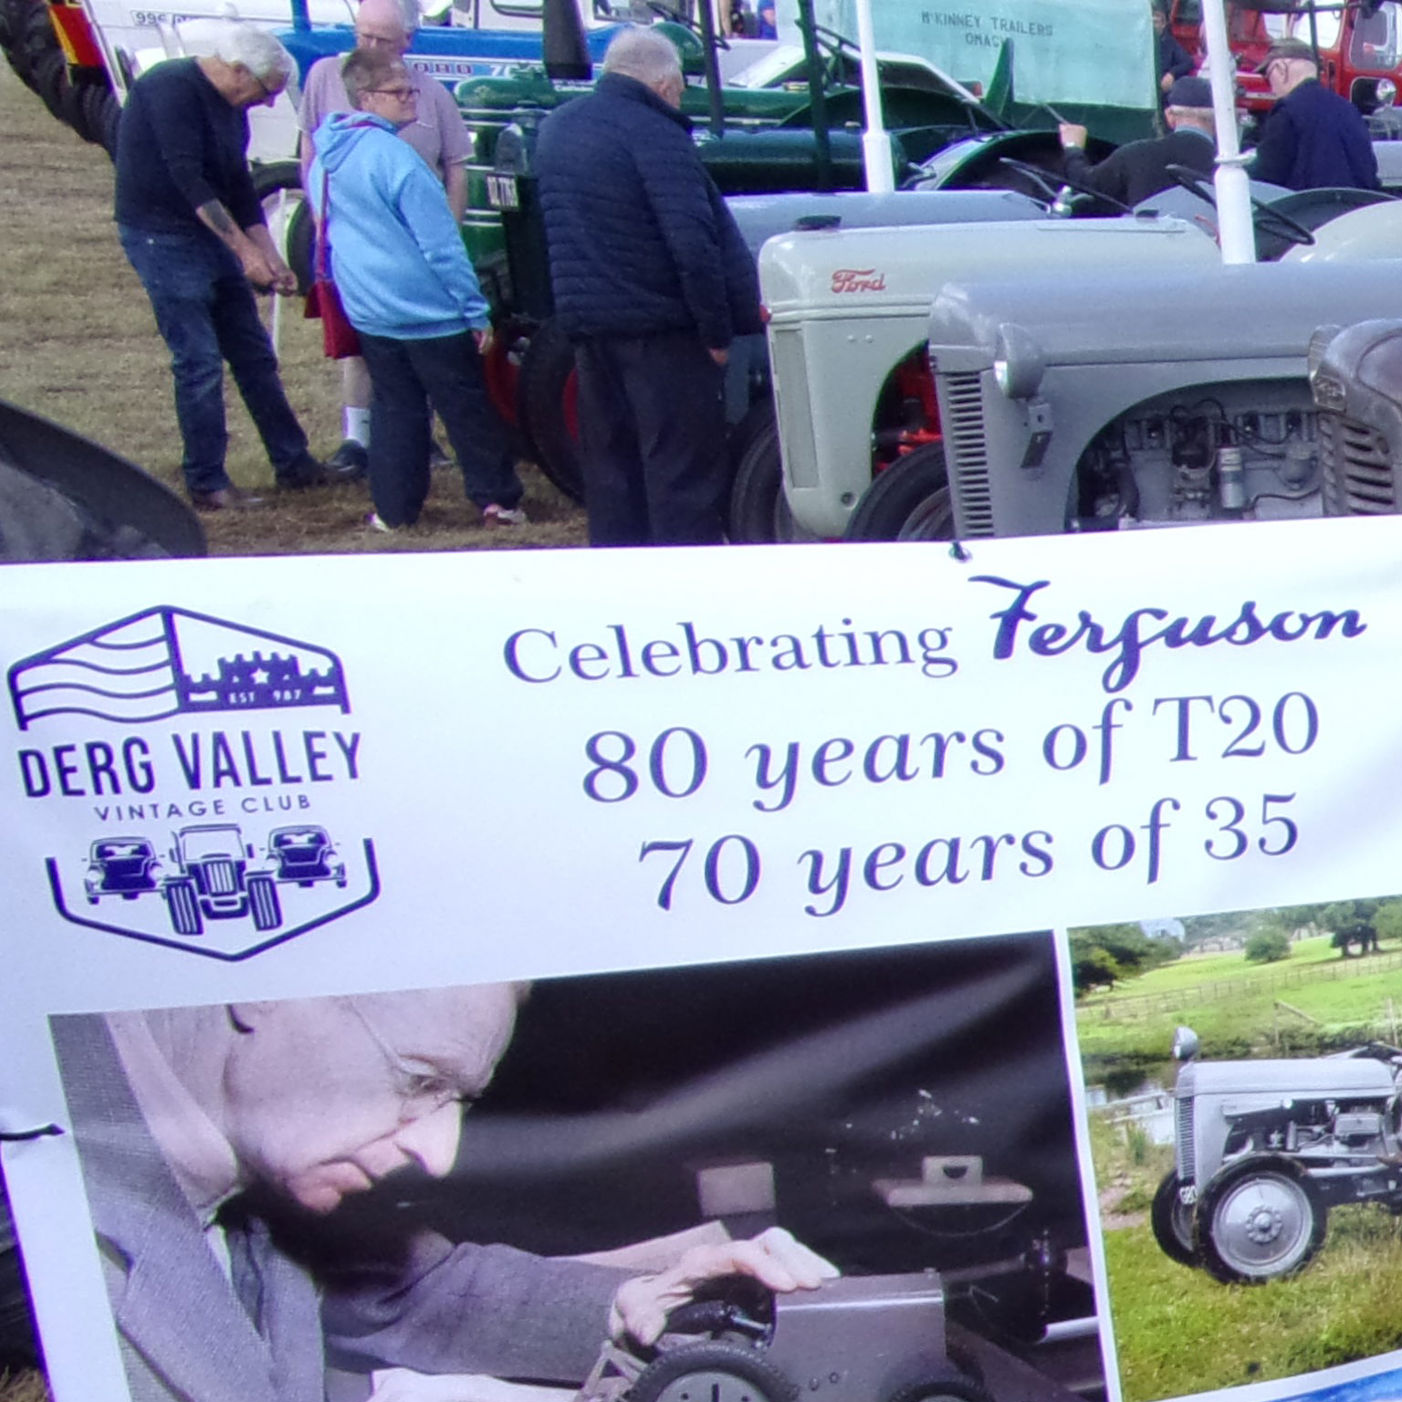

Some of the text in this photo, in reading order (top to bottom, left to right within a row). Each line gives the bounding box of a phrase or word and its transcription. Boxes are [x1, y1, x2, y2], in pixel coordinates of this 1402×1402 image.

[965, 32, 1002, 48] OMAG
[990, 17, 1053, 36] TRAILERS
[831, 267, 887, 294] Ford
[503, 574, 1367, 693] Celebrating Ferguson
[18, 730, 361, 798] DERG VALLEY
[582, 691, 1319, 813] 80 years of T20
[94, 795, 311, 822] VINTAGE CLUB
[639, 793, 1299, 918] 70 years of 35
